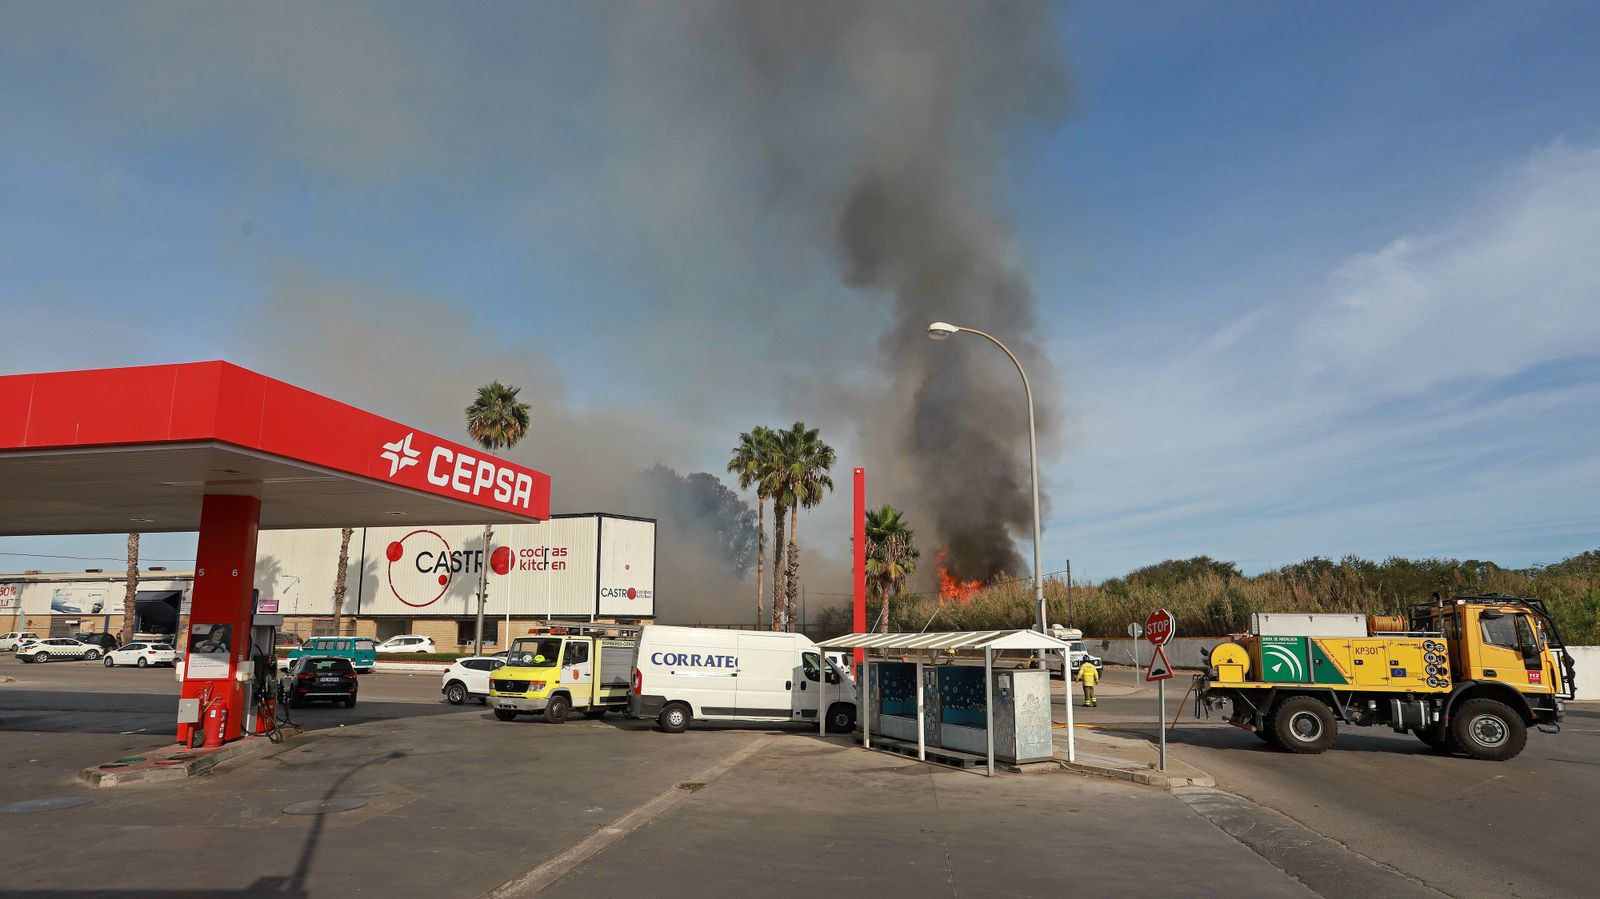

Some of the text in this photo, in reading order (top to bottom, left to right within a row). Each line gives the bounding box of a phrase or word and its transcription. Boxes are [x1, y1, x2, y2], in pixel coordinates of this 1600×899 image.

[427, 445, 533, 509] CEPSA
[198, 568, 205, 577] 5
[231, 568, 238, 577] 6
[1147, 619, 1169, 635] STOP
[1355, 647, 1379, 655] KP301
